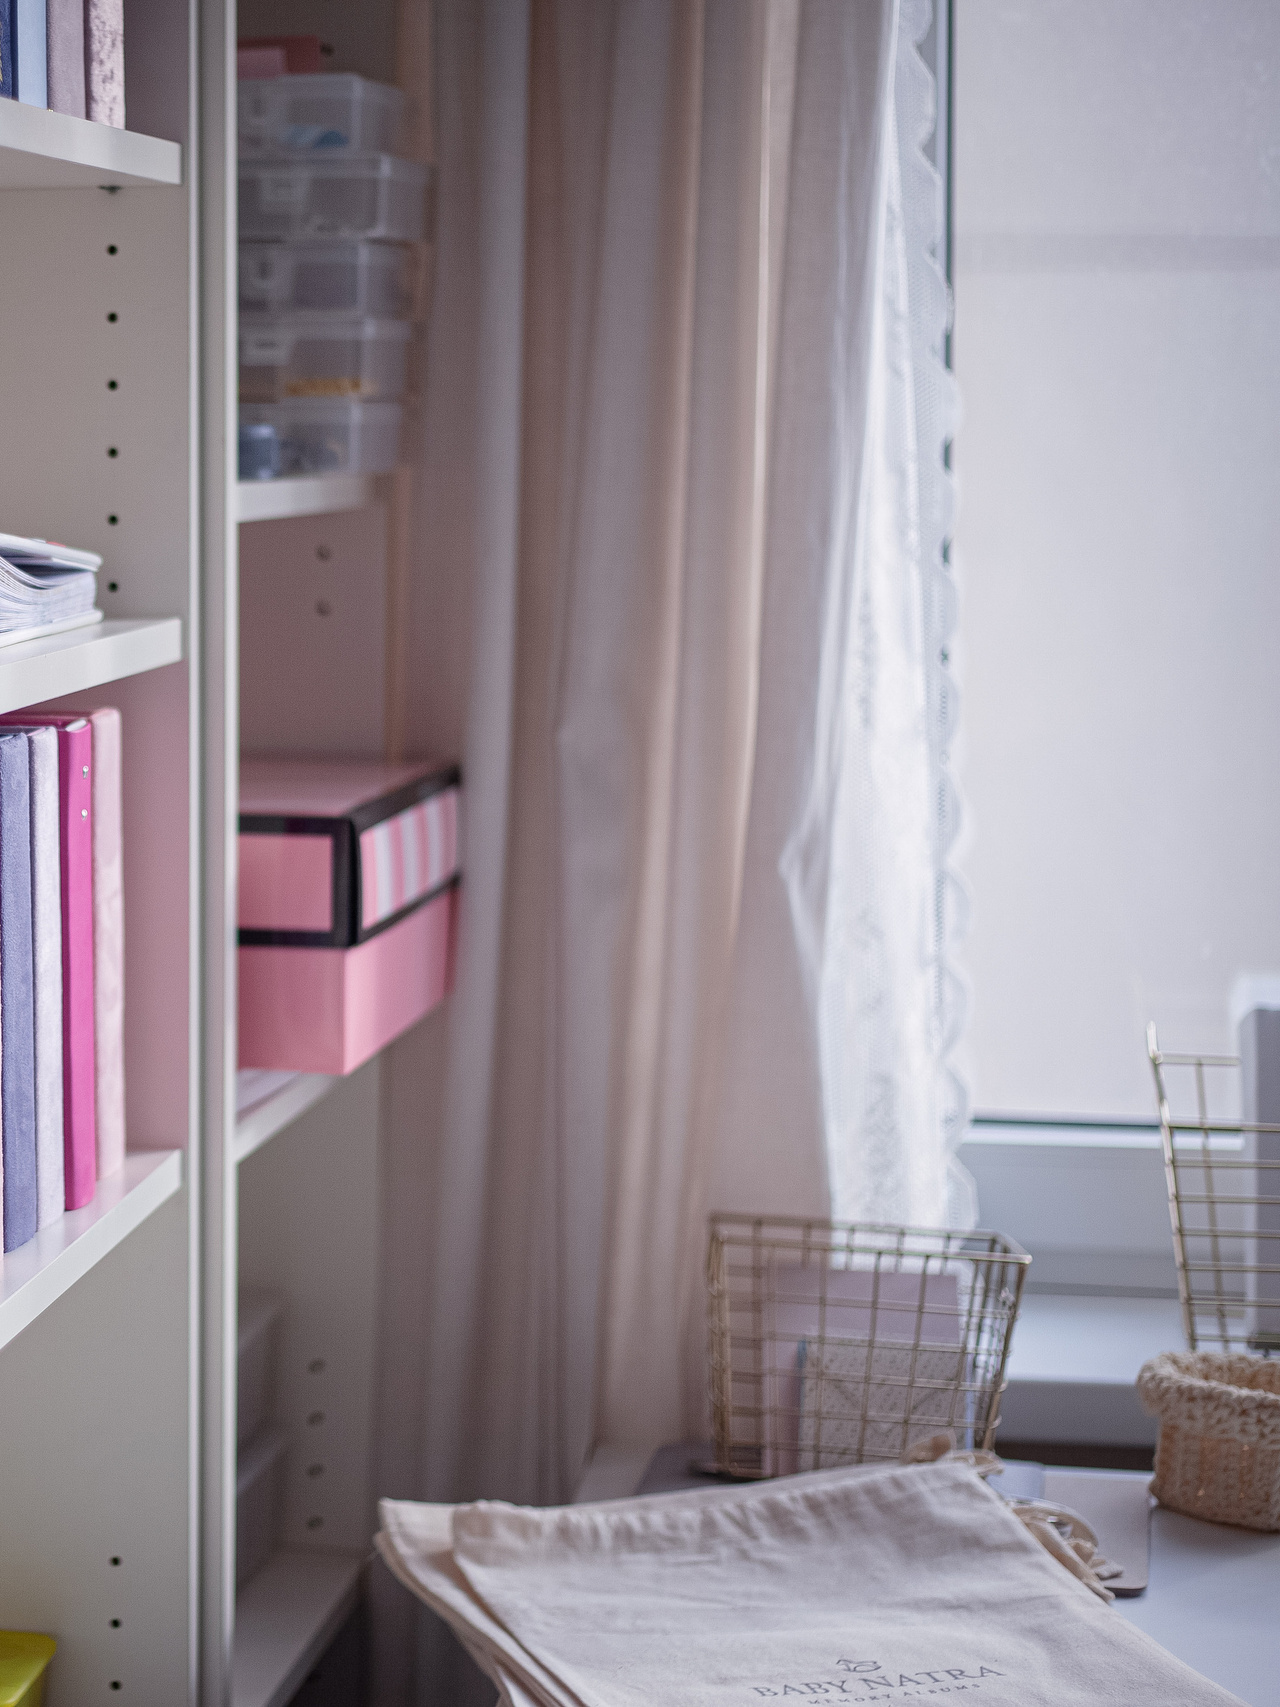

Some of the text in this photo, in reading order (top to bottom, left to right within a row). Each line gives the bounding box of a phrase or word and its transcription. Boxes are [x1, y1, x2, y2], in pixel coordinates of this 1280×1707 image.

[750, 1665, 1006, 1697] BABY NATRA
[807, 1683, 981, 1704] MEMORY ALBUMS
